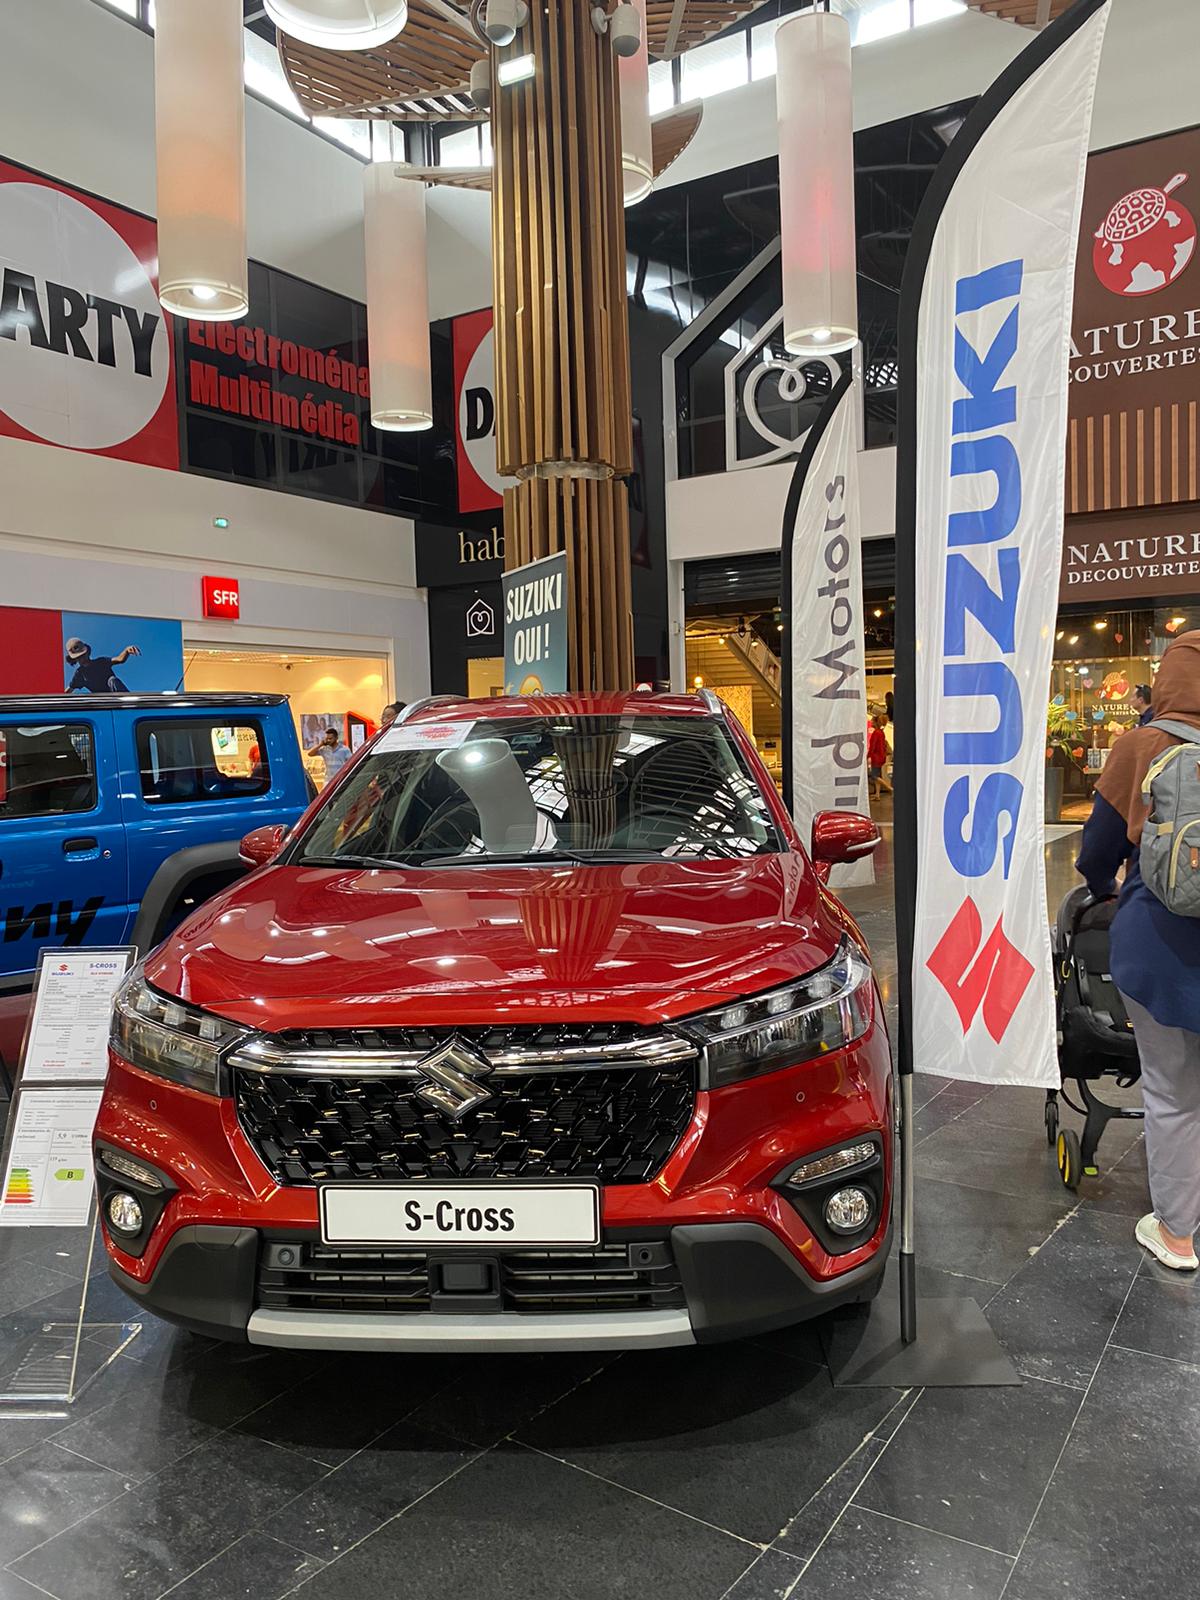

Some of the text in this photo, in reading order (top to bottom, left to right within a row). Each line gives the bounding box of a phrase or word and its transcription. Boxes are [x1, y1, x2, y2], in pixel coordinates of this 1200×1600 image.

[0, 267, 160, 378] ARTY
[189, 359, 361, 446] Multimédia
[213, 589, 238, 606] SFR
[506, 573, 562, 625] SUZUKI
[810, 475, 862, 700] Motors
[944, 259, 1023, 880] SUZUKI
[67, 1170, 74, 1179] B
[404, 1200, 515, 1232] S-Cross
